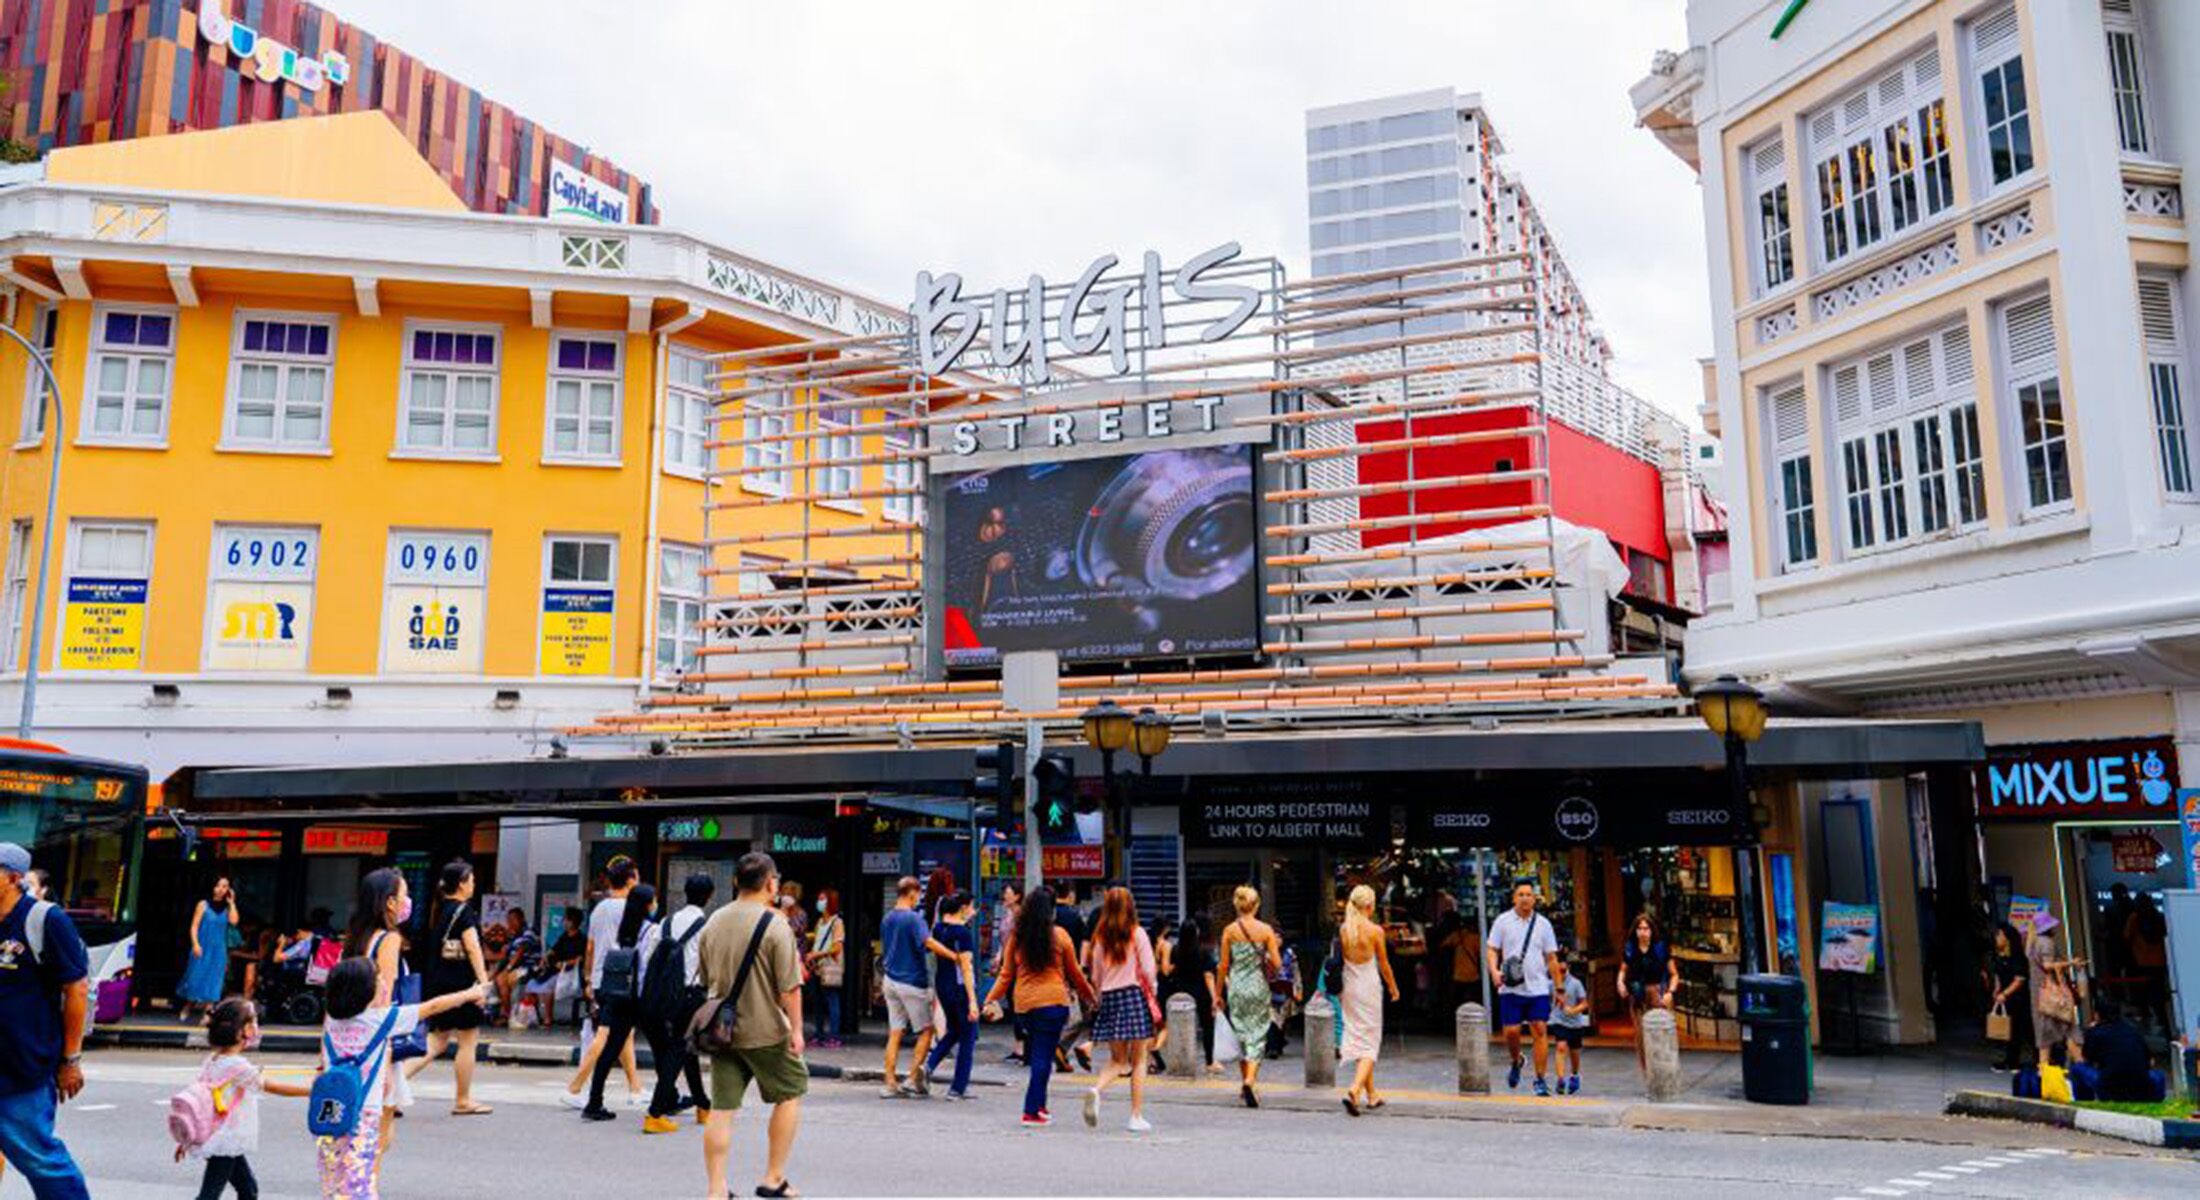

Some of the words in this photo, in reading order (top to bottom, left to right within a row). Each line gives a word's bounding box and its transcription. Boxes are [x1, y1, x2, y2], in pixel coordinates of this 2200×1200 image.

[910, 241, 1262, 384] BUGIS
[953, 395, 1224, 456] STREET
[227, 540, 308, 567] 6902
[401, 543, 478, 571] 0960
[409, 636, 459, 651] SAE
[1988, 756, 2129, 806] MIXUE
[1204, 804, 1221, 818] 24
[1224, 803, 1276, 819] HOURS
[1279, 803, 1370, 818] PEDESTRIAN
[1433, 813, 1491, 827] SEIKO
[1667, 809, 1730, 825] SEIKO
[1209, 823, 1242, 838] LINK
[1246, 822, 1265, 837] TO
[1267, 822, 1322, 838] ALBERT
[1326, 822, 1364, 837] MALL
